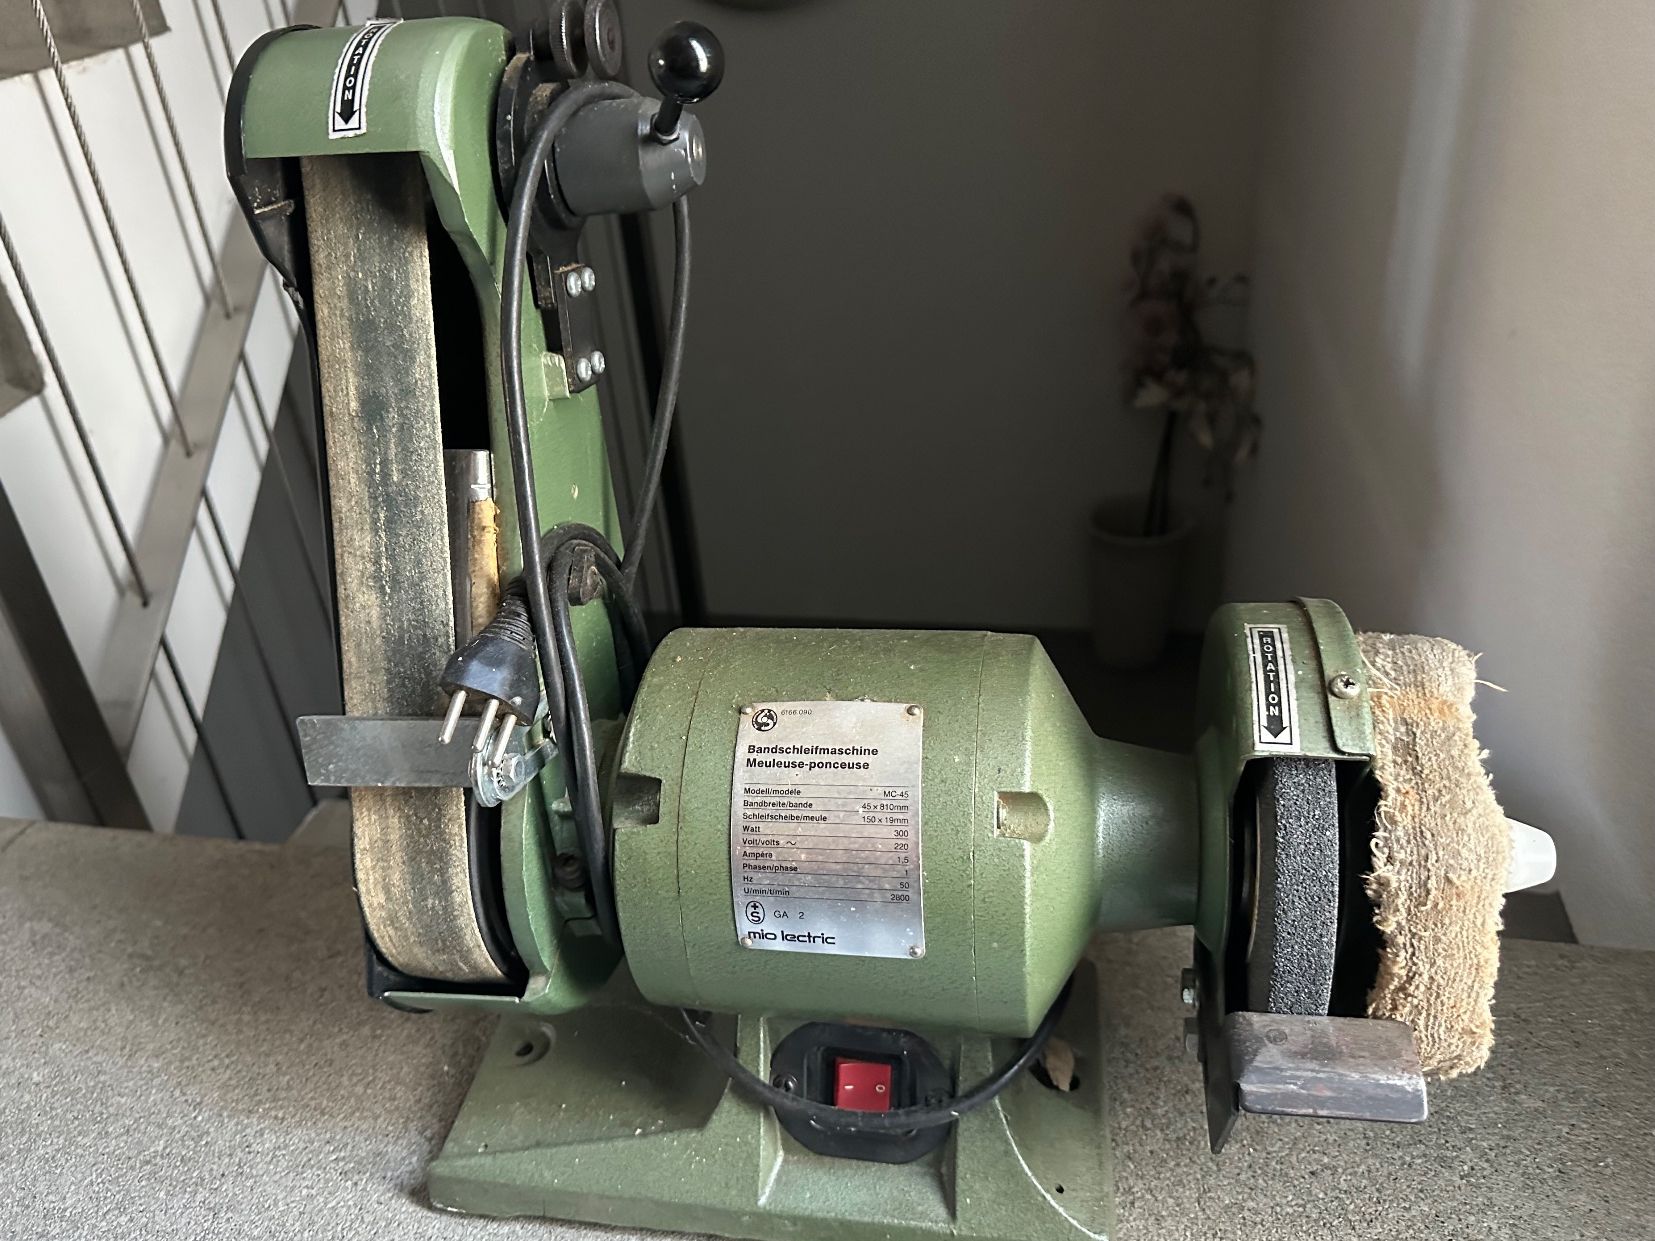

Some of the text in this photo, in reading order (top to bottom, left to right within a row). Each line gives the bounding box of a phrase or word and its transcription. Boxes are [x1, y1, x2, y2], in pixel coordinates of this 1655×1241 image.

[344, 27, 378, 100] ROTATION
[1262, 637, 1279, 716] ROTATION
[747, 744, 879, 756] Bandschleifmaschine
[746, 757, 870, 771] Meuleuse-ponceuse
[883, 790, 909, 799] MC-45
[743, 800, 813, 809] Bandbreite/bande
[861, 802, 872, 811] 45
[879, 803, 909, 811] 810mm
[742, 812, 828, 822] Schleifscheibe/meule
[862, 815, 876, 823] 150
[884, 816, 909, 824] 19mm
[742, 825, 909, 838] Watt 300
[742, 838, 909, 851] Volt/volts 220
[742, 862, 799, 873] Phasen/phase
[743, 875, 910, 889] Hz 50
[743, 887, 910, 902] U/min/t/min 2800
[773, 909, 789, 919] GA
[798, 911, 805, 920] 2
[748, 929, 836, 945] mio lectric
